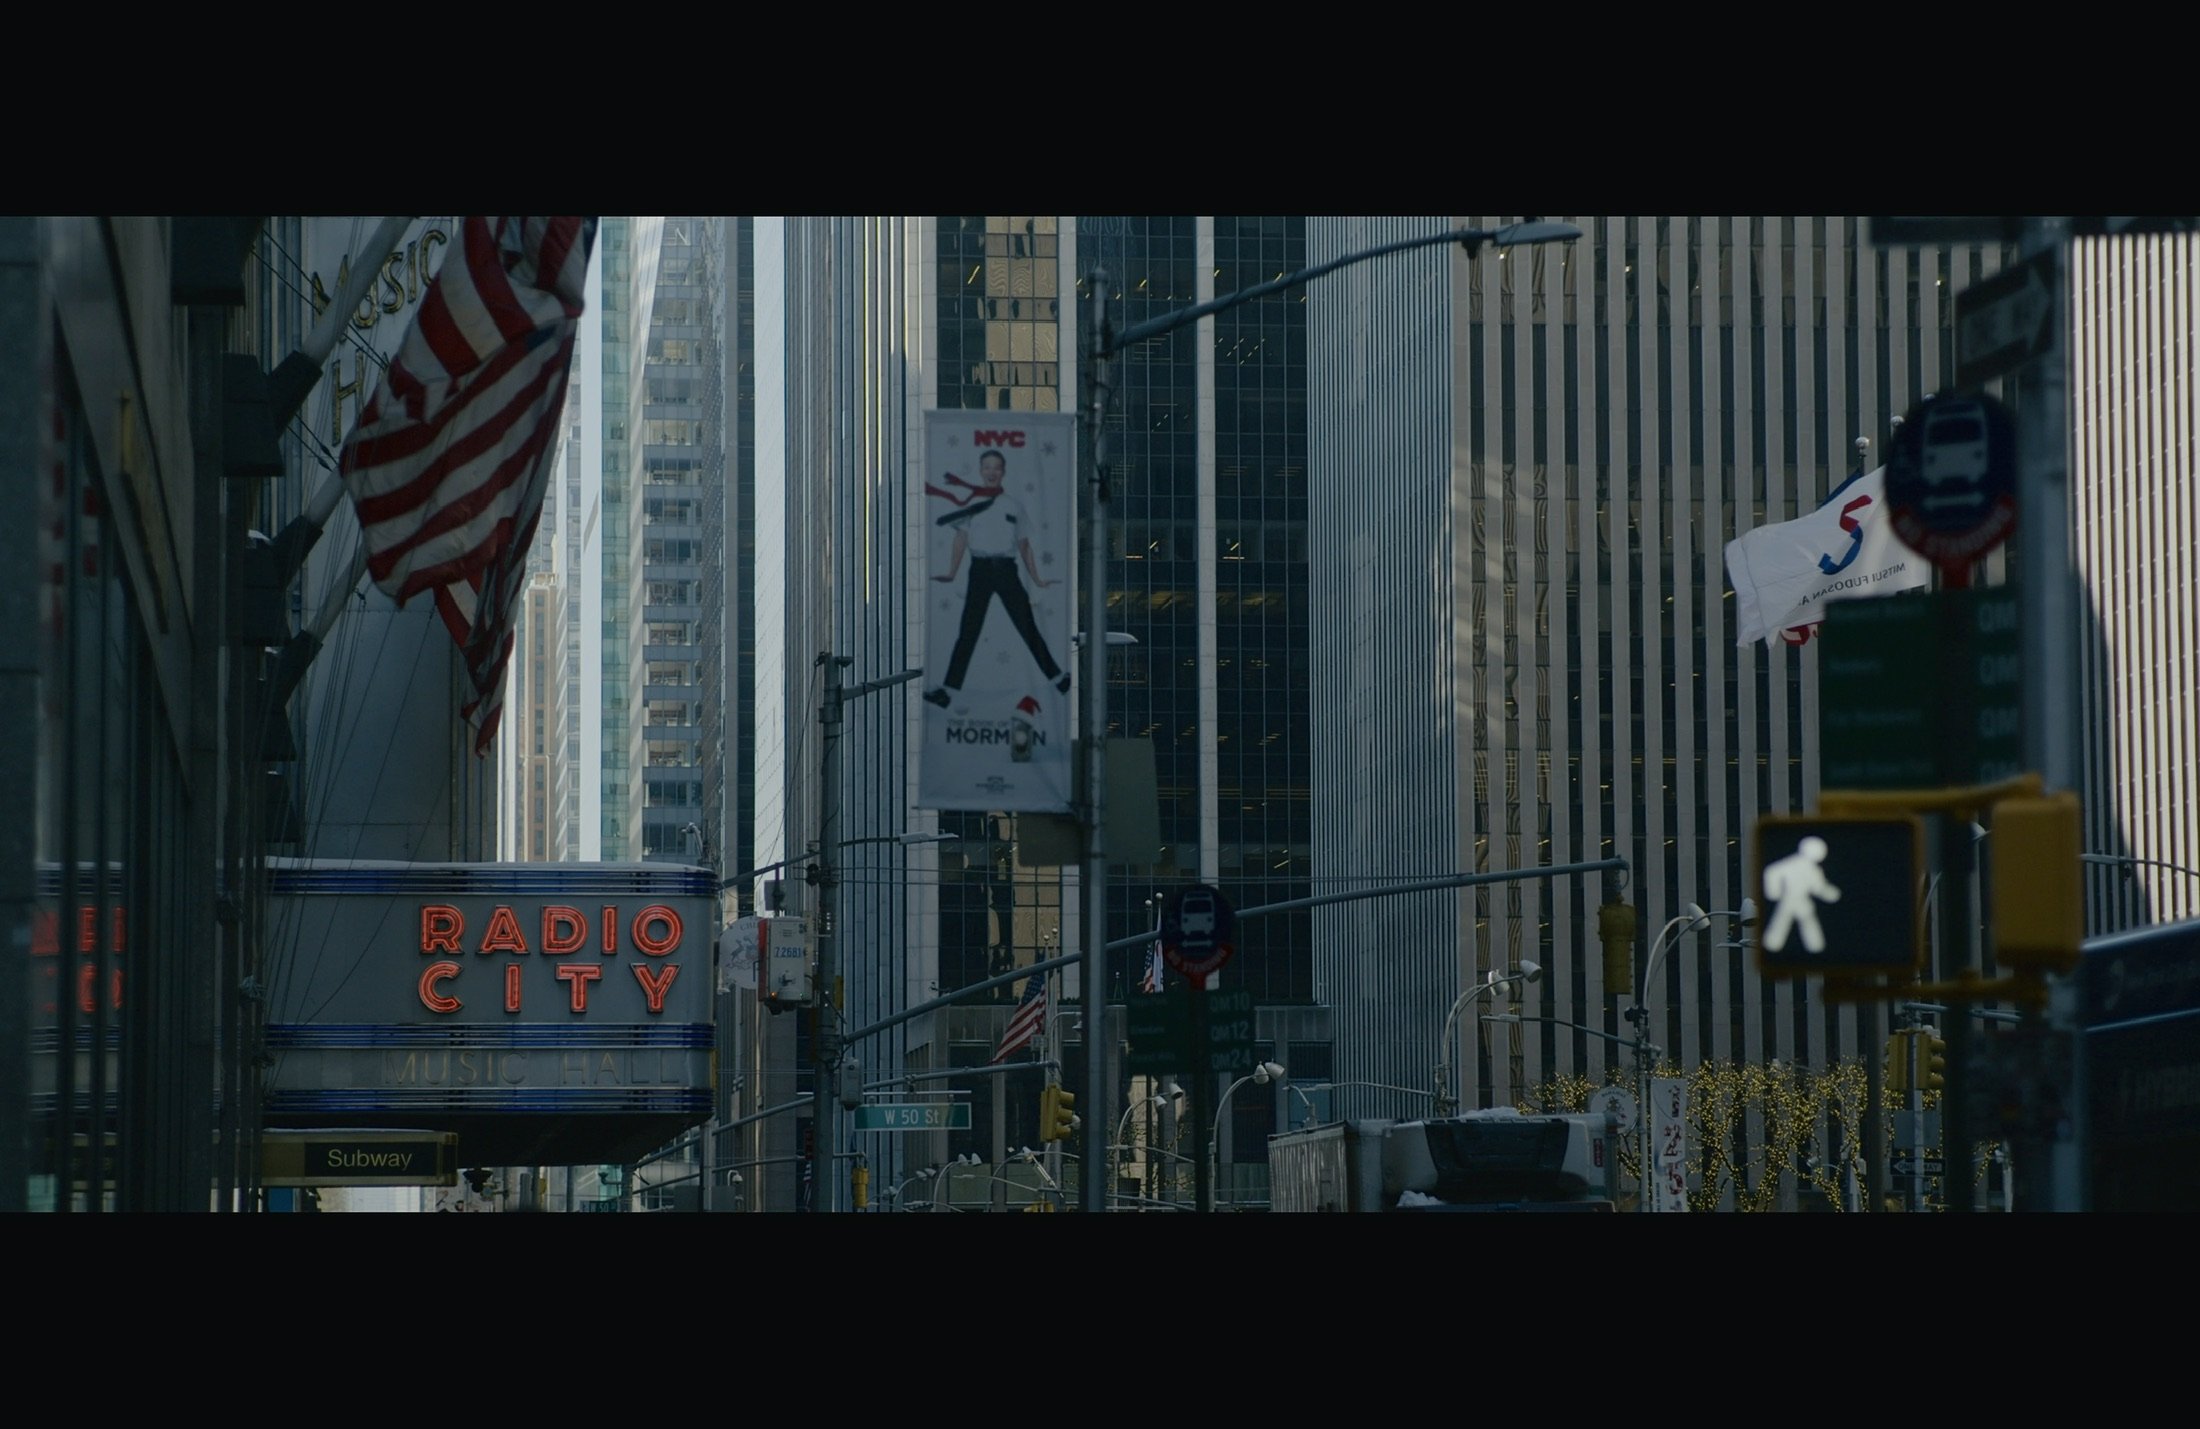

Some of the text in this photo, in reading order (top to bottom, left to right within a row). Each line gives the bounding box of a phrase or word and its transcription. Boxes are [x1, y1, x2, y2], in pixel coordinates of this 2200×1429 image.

[974, 430, 1026, 448] NYC
[420, 903, 684, 956] RADIO
[774, 946, 802, 958] 72681
[418, 960, 682, 1014] CITY
[385, 1050, 681, 1084] MUSIC HALL
[885, 1108, 939, 1125] W 50 St
[327, 1149, 413, 1171] Subway
